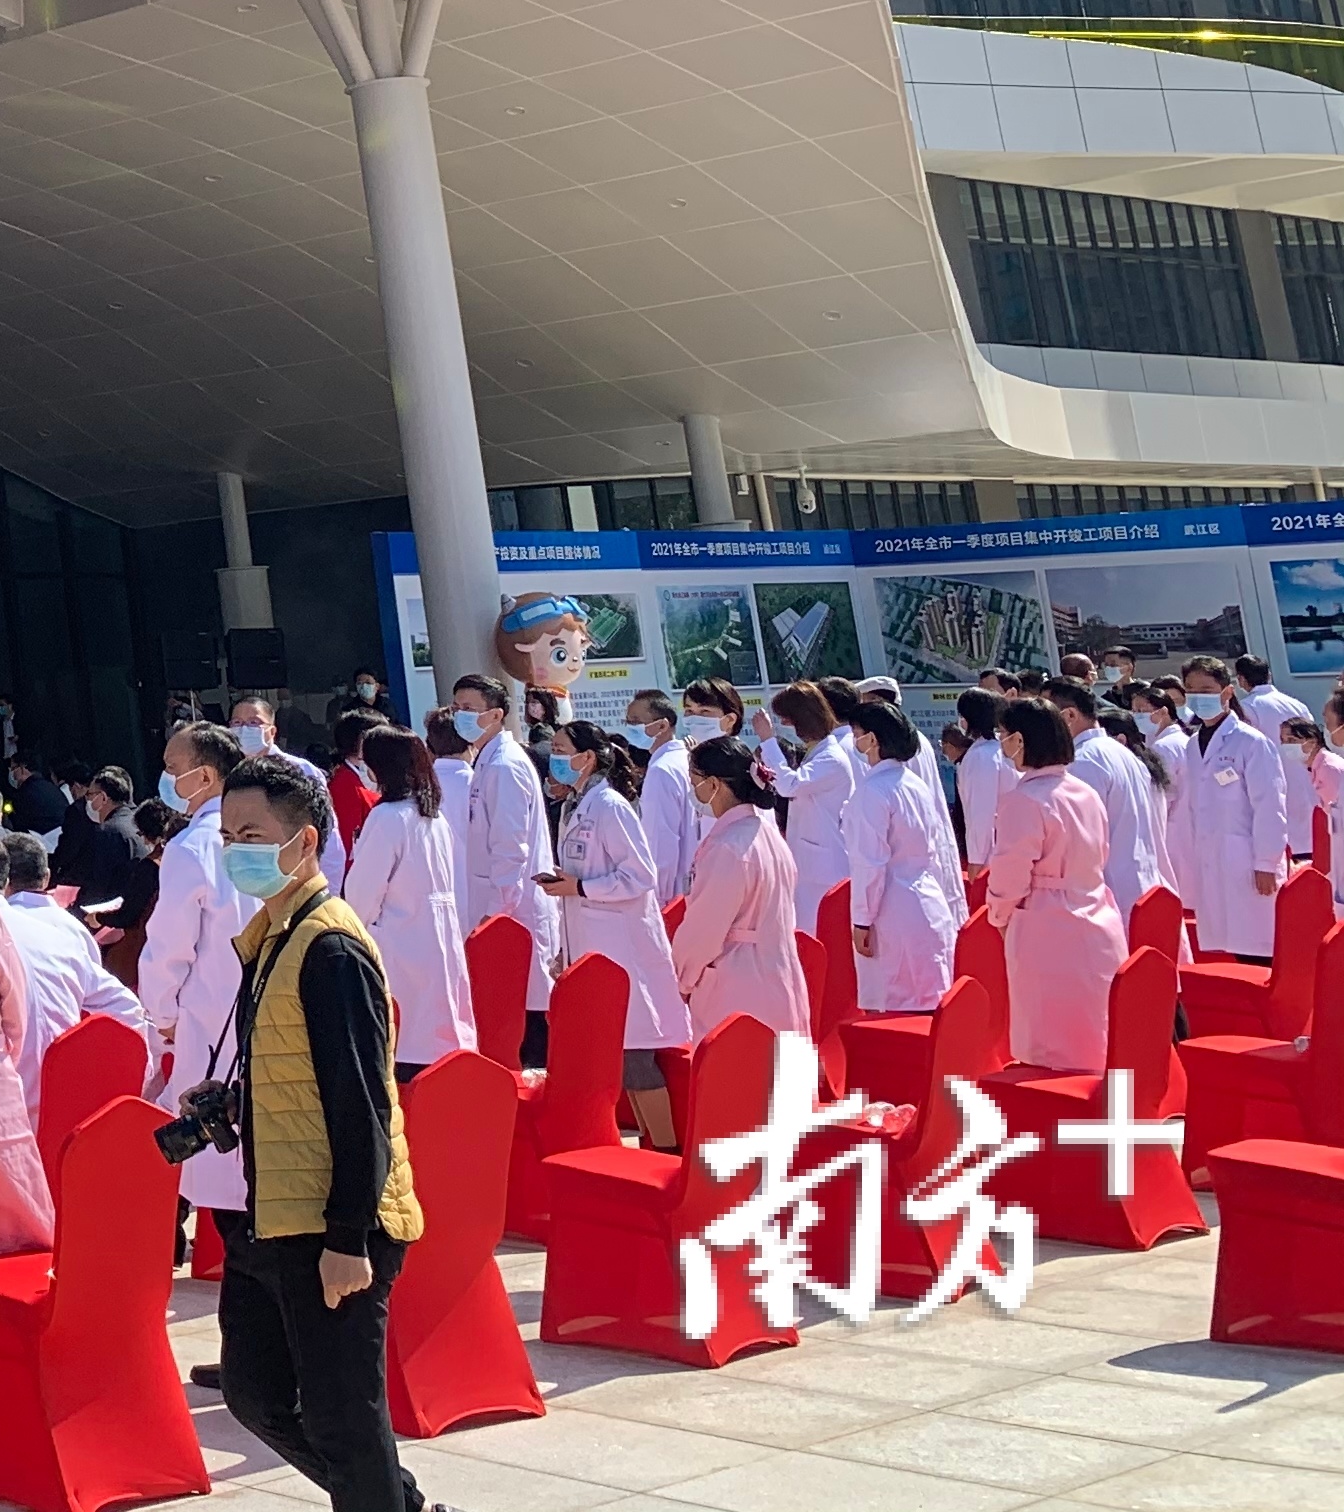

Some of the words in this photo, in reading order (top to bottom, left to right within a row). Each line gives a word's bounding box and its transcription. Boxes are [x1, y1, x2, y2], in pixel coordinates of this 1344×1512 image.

[651, 541, 811, 557] 2021年全市一季度项目集中开竣工项目介绍
[875, 524, 1160, 553] 2021年全市一季度项目集中开竣工项目介绍
